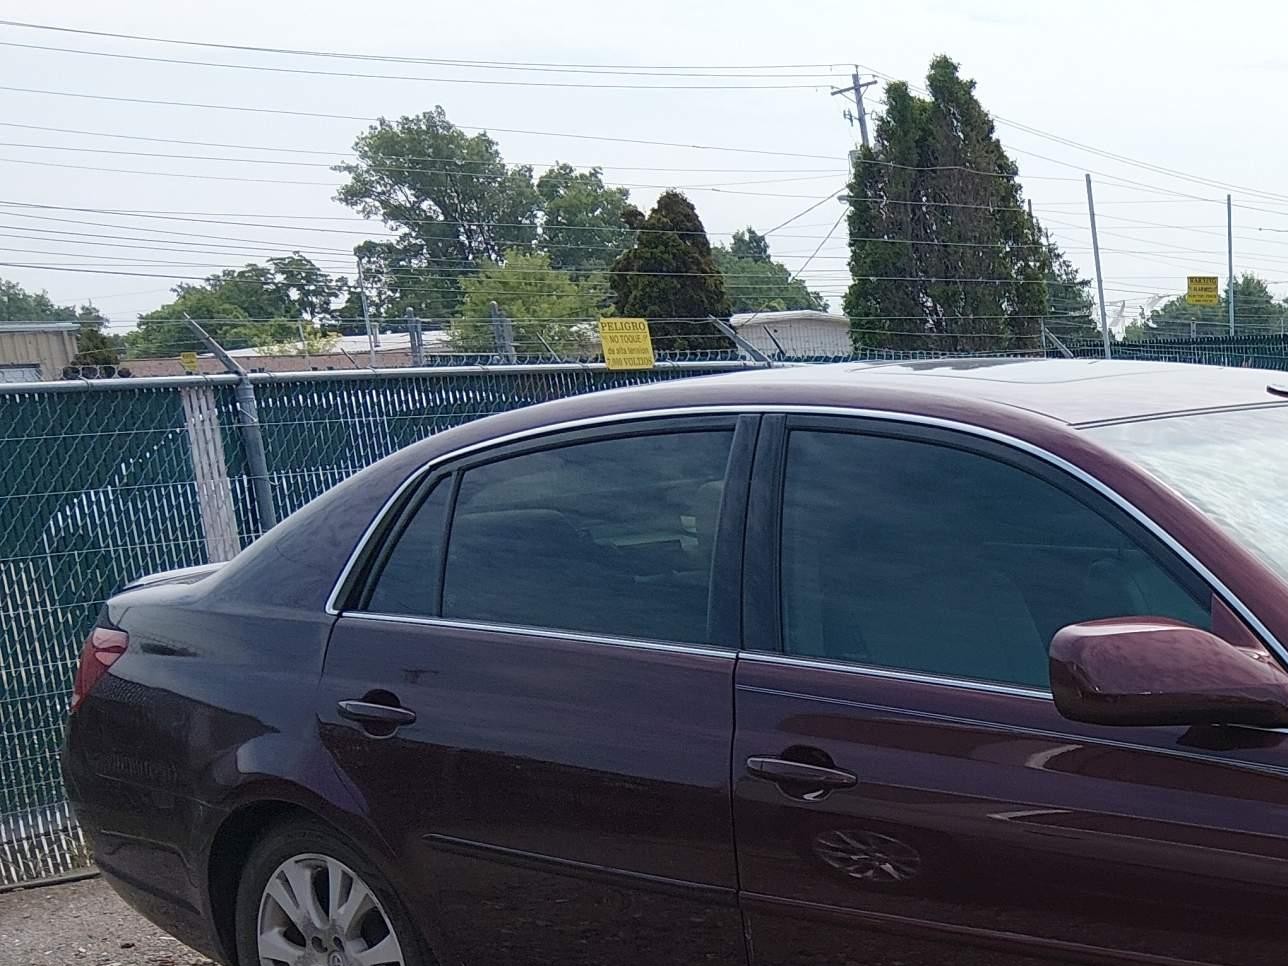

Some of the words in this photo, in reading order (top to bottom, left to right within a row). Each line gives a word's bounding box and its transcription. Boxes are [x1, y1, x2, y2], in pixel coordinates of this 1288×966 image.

[601, 321, 645, 331] PELIGRO
[610, 334, 619, 343] NO
[620, 334, 641, 344] TOQUE
